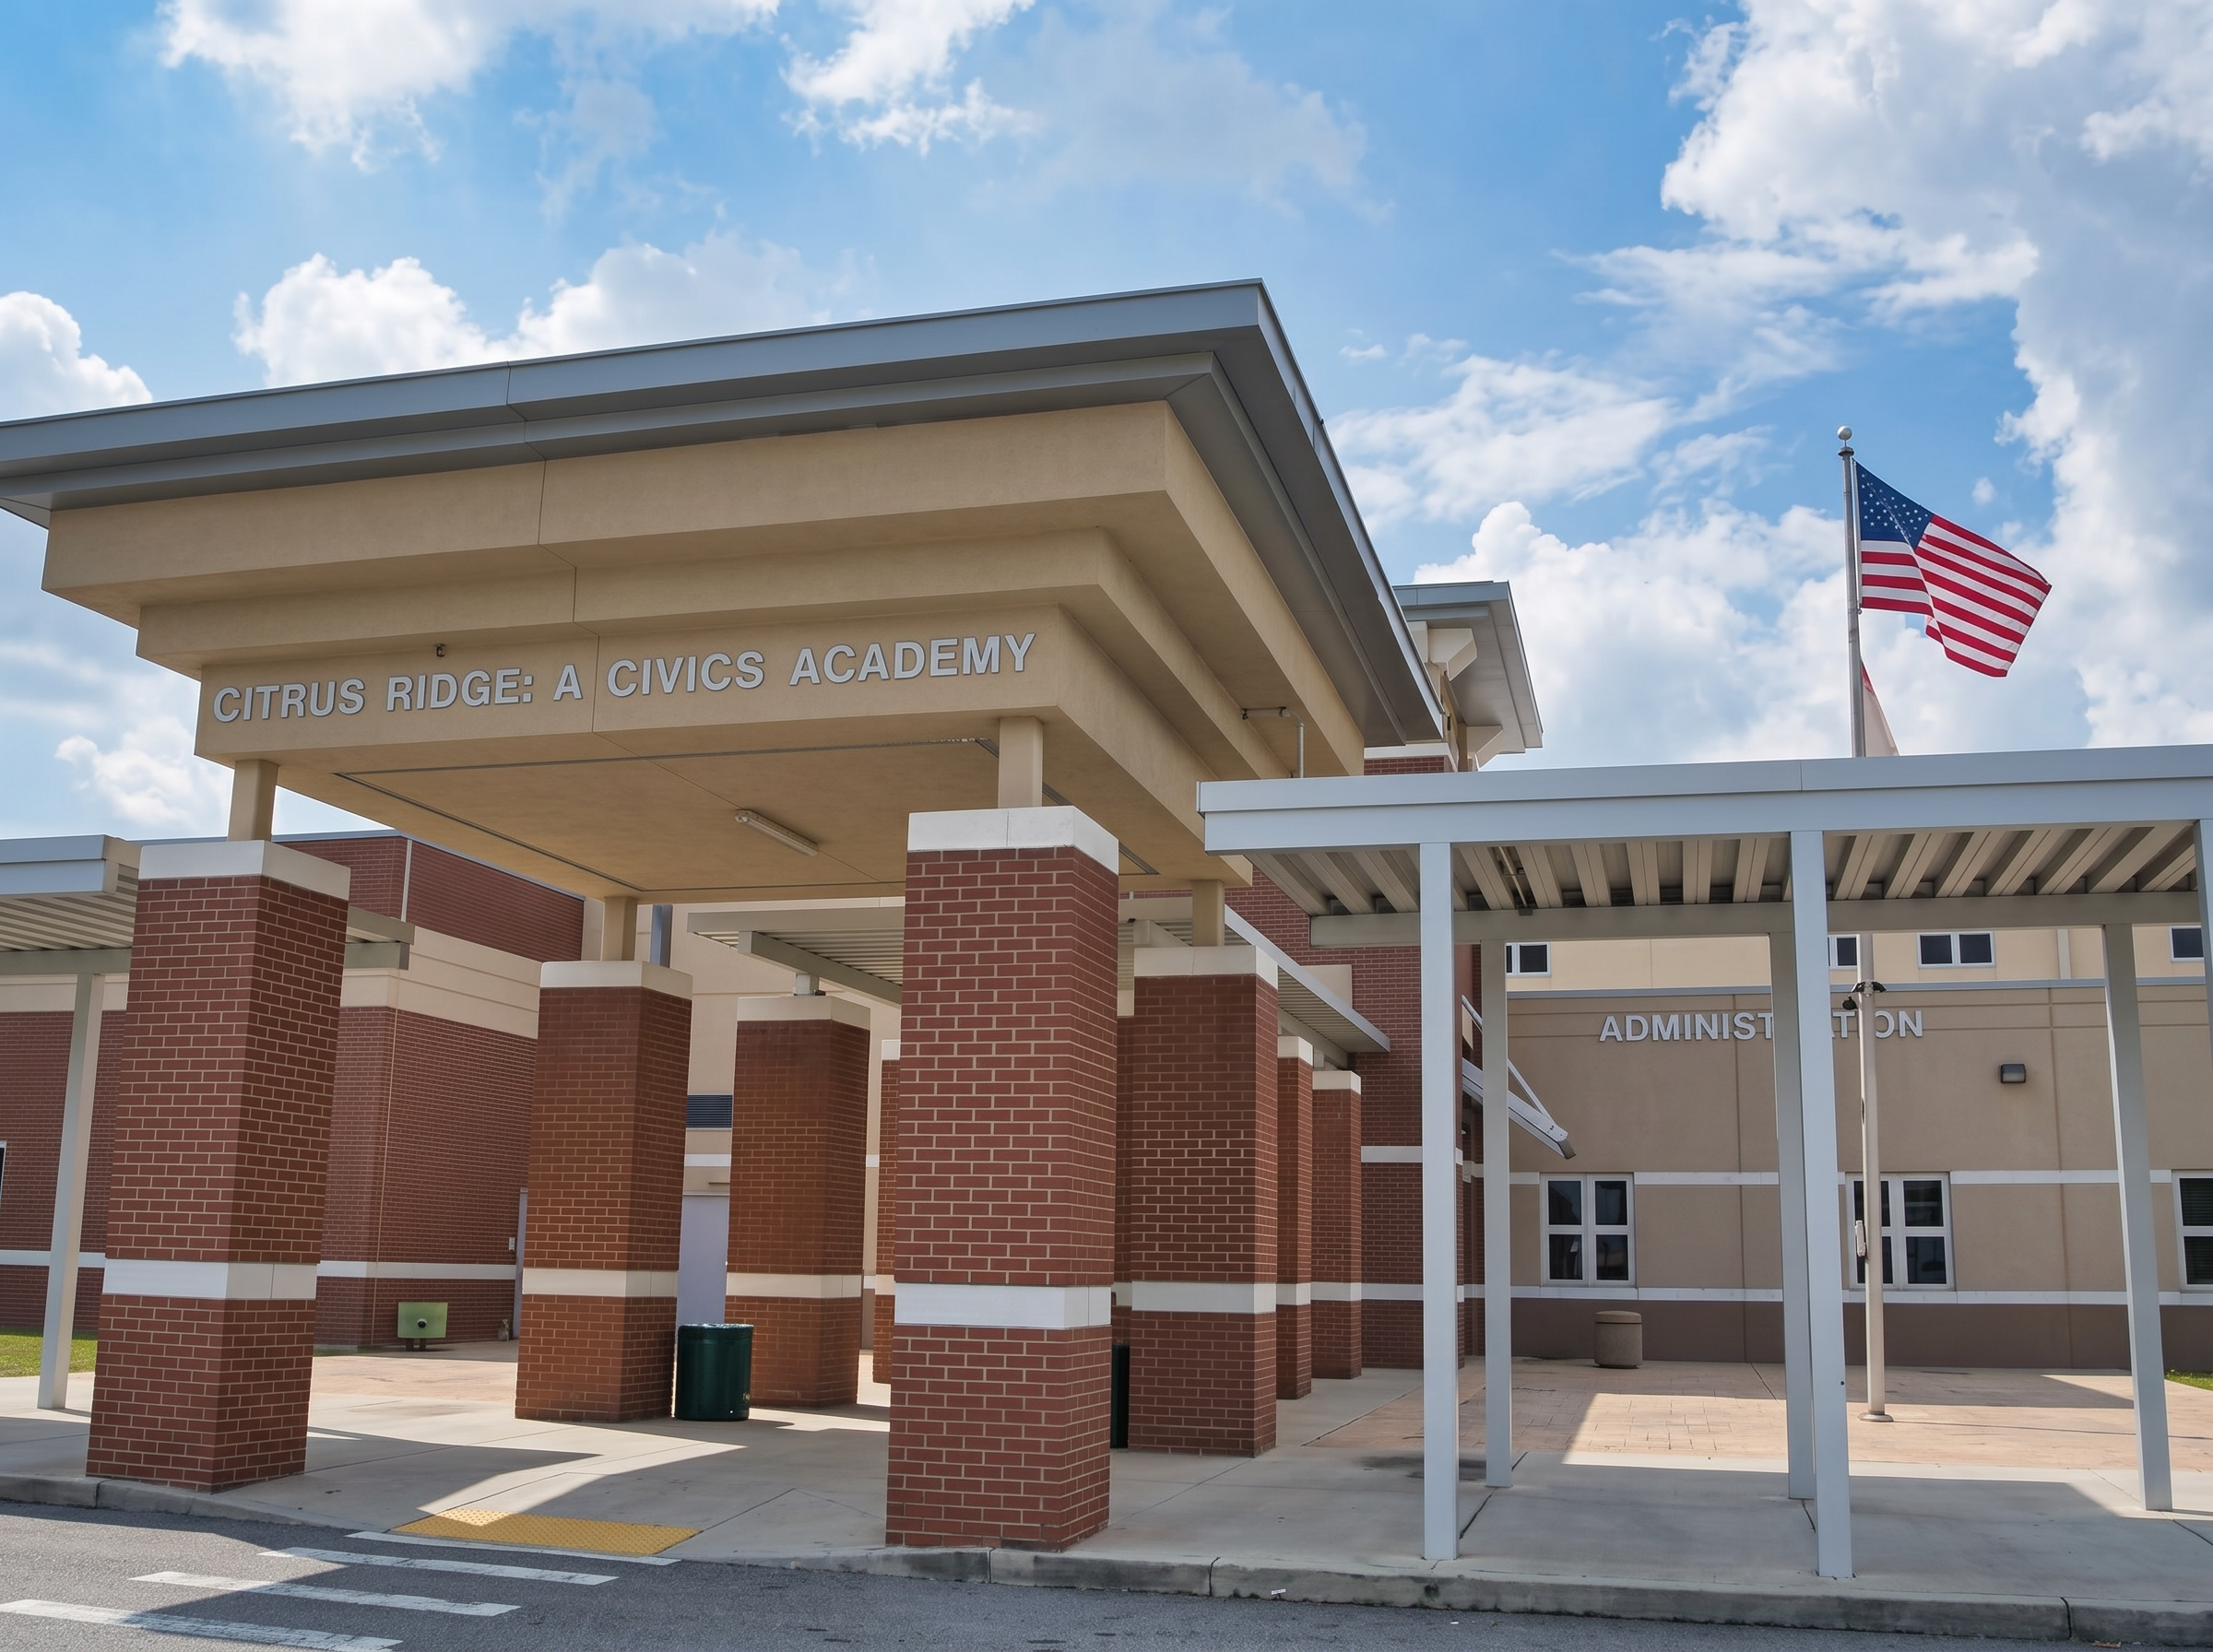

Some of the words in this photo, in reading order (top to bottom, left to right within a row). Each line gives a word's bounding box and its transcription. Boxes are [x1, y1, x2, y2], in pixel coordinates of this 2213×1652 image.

[213, 678, 365, 723] CITRUS
[386, 667, 534, 712] RIDGE:
[553, 664, 584, 702] A
[607, 650, 765, 697] CIVICS
[789, 632, 1036, 686] ACADEMY
[1599, 1009, 1923, 1043] ADMINISTTON
